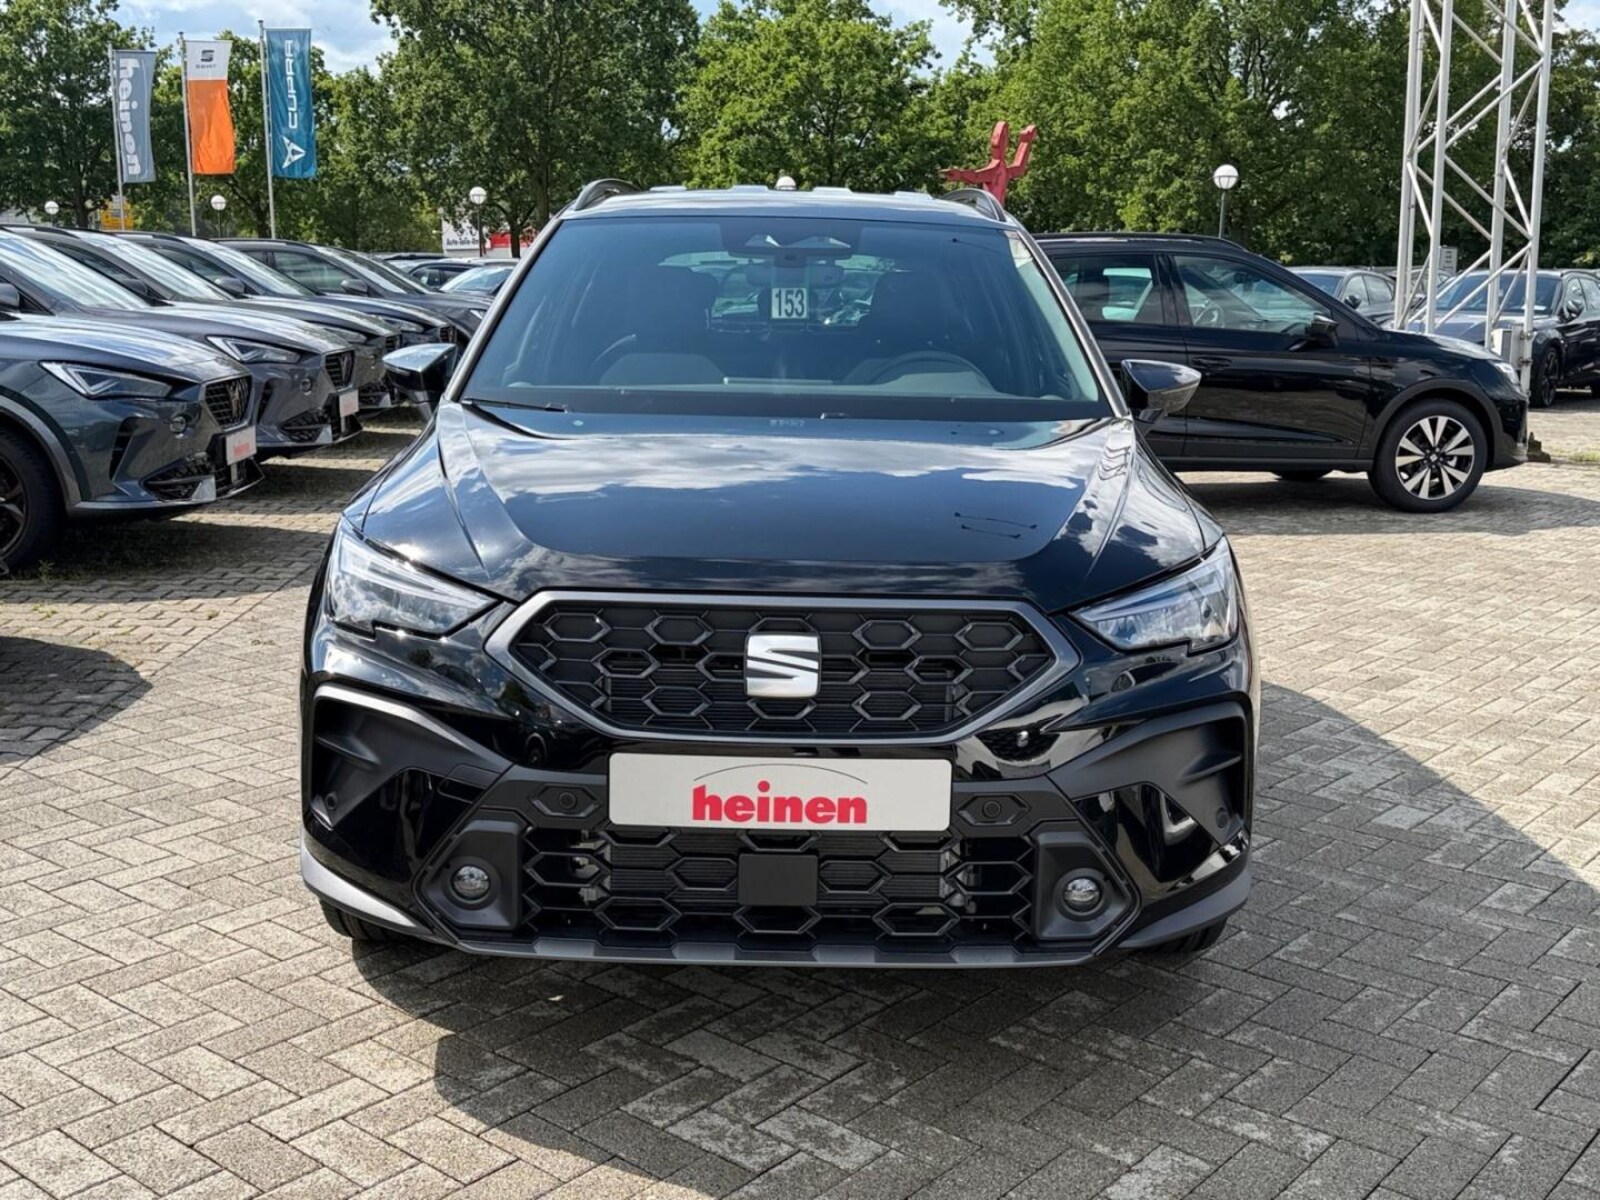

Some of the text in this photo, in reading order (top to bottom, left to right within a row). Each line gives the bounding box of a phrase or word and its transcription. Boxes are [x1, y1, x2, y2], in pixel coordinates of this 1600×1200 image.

[119, 58, 141, 175] heinen
[285, 39, 298, 129] CUPRA
[774, 289, 805, 317] 153
[692, 780, 867, 824] heinen
